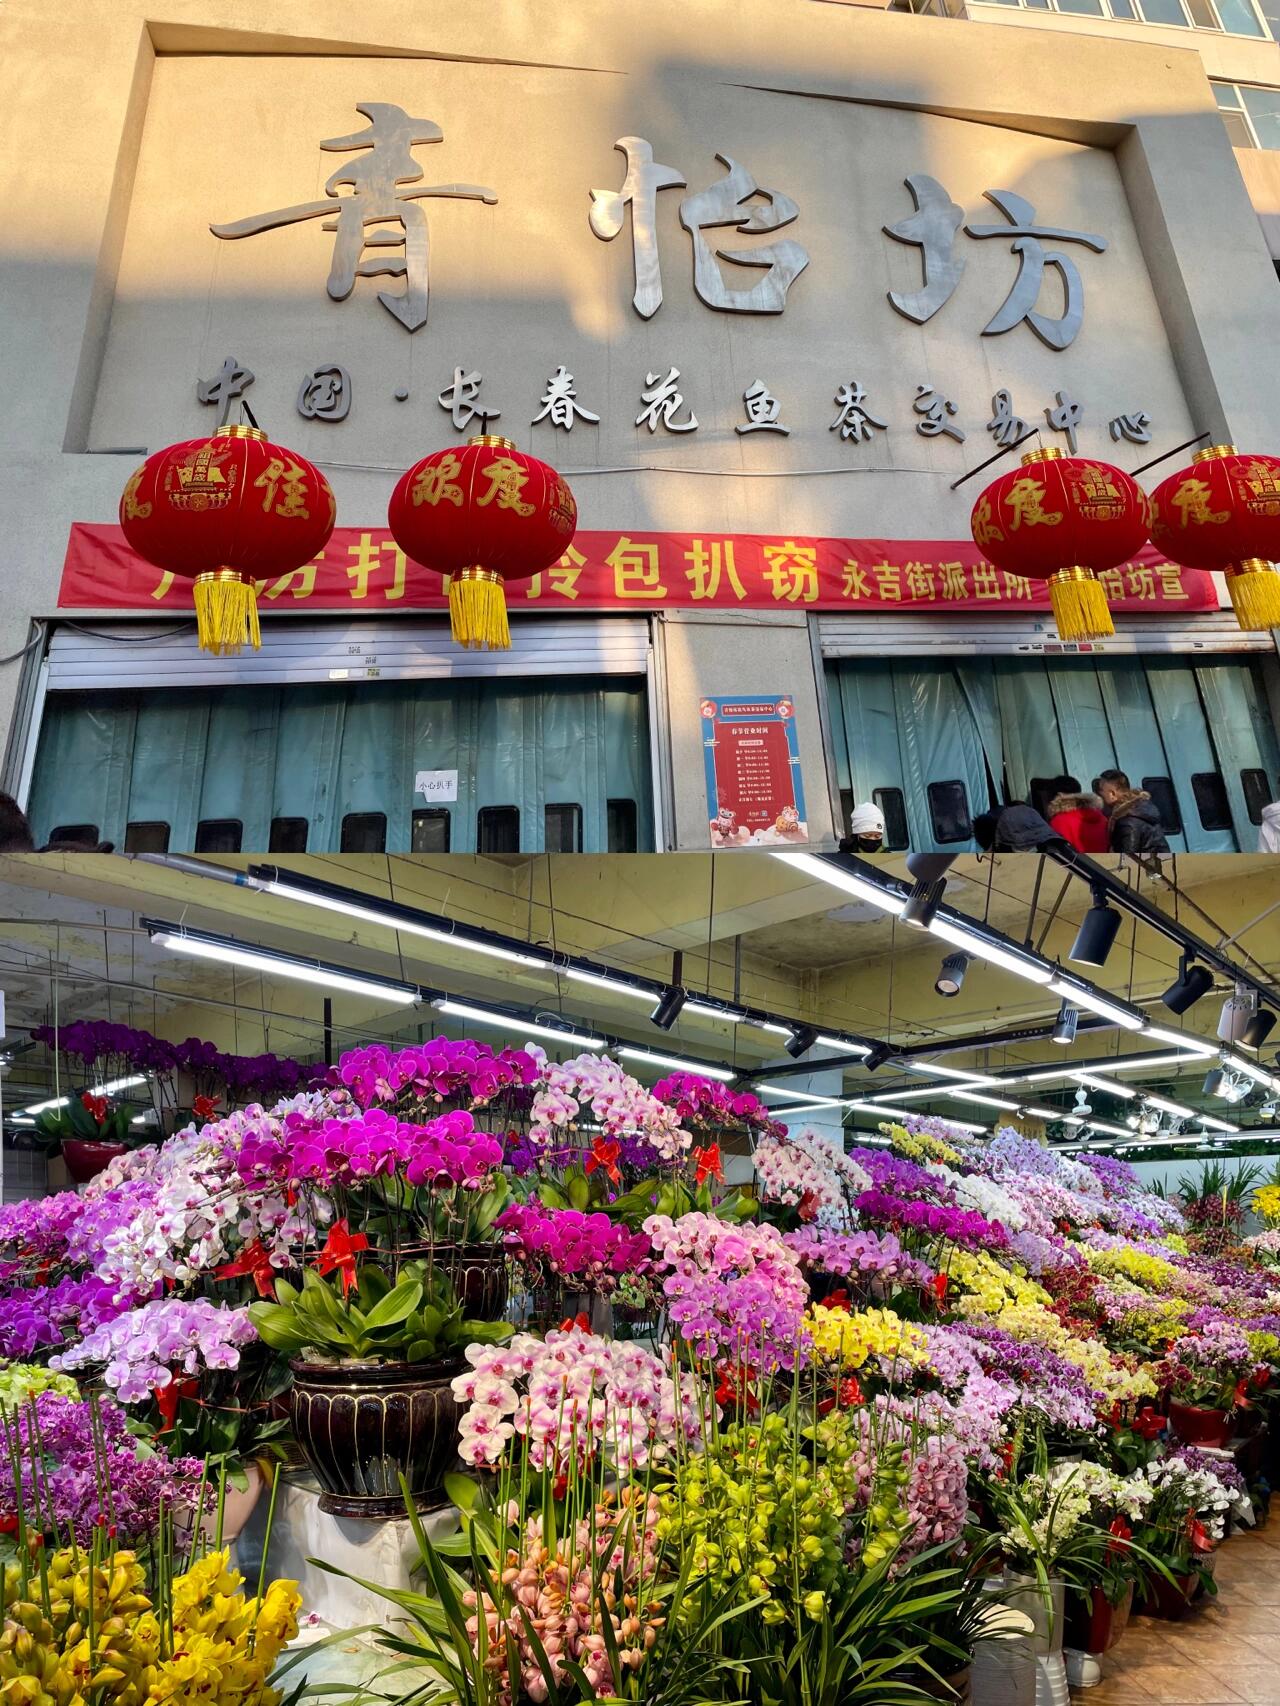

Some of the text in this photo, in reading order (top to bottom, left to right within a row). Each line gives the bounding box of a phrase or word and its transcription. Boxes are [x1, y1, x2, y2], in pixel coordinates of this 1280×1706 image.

[209, 102, 1108, 351] 青怡坊
[419, 780, 453, 791] 小心扒手
